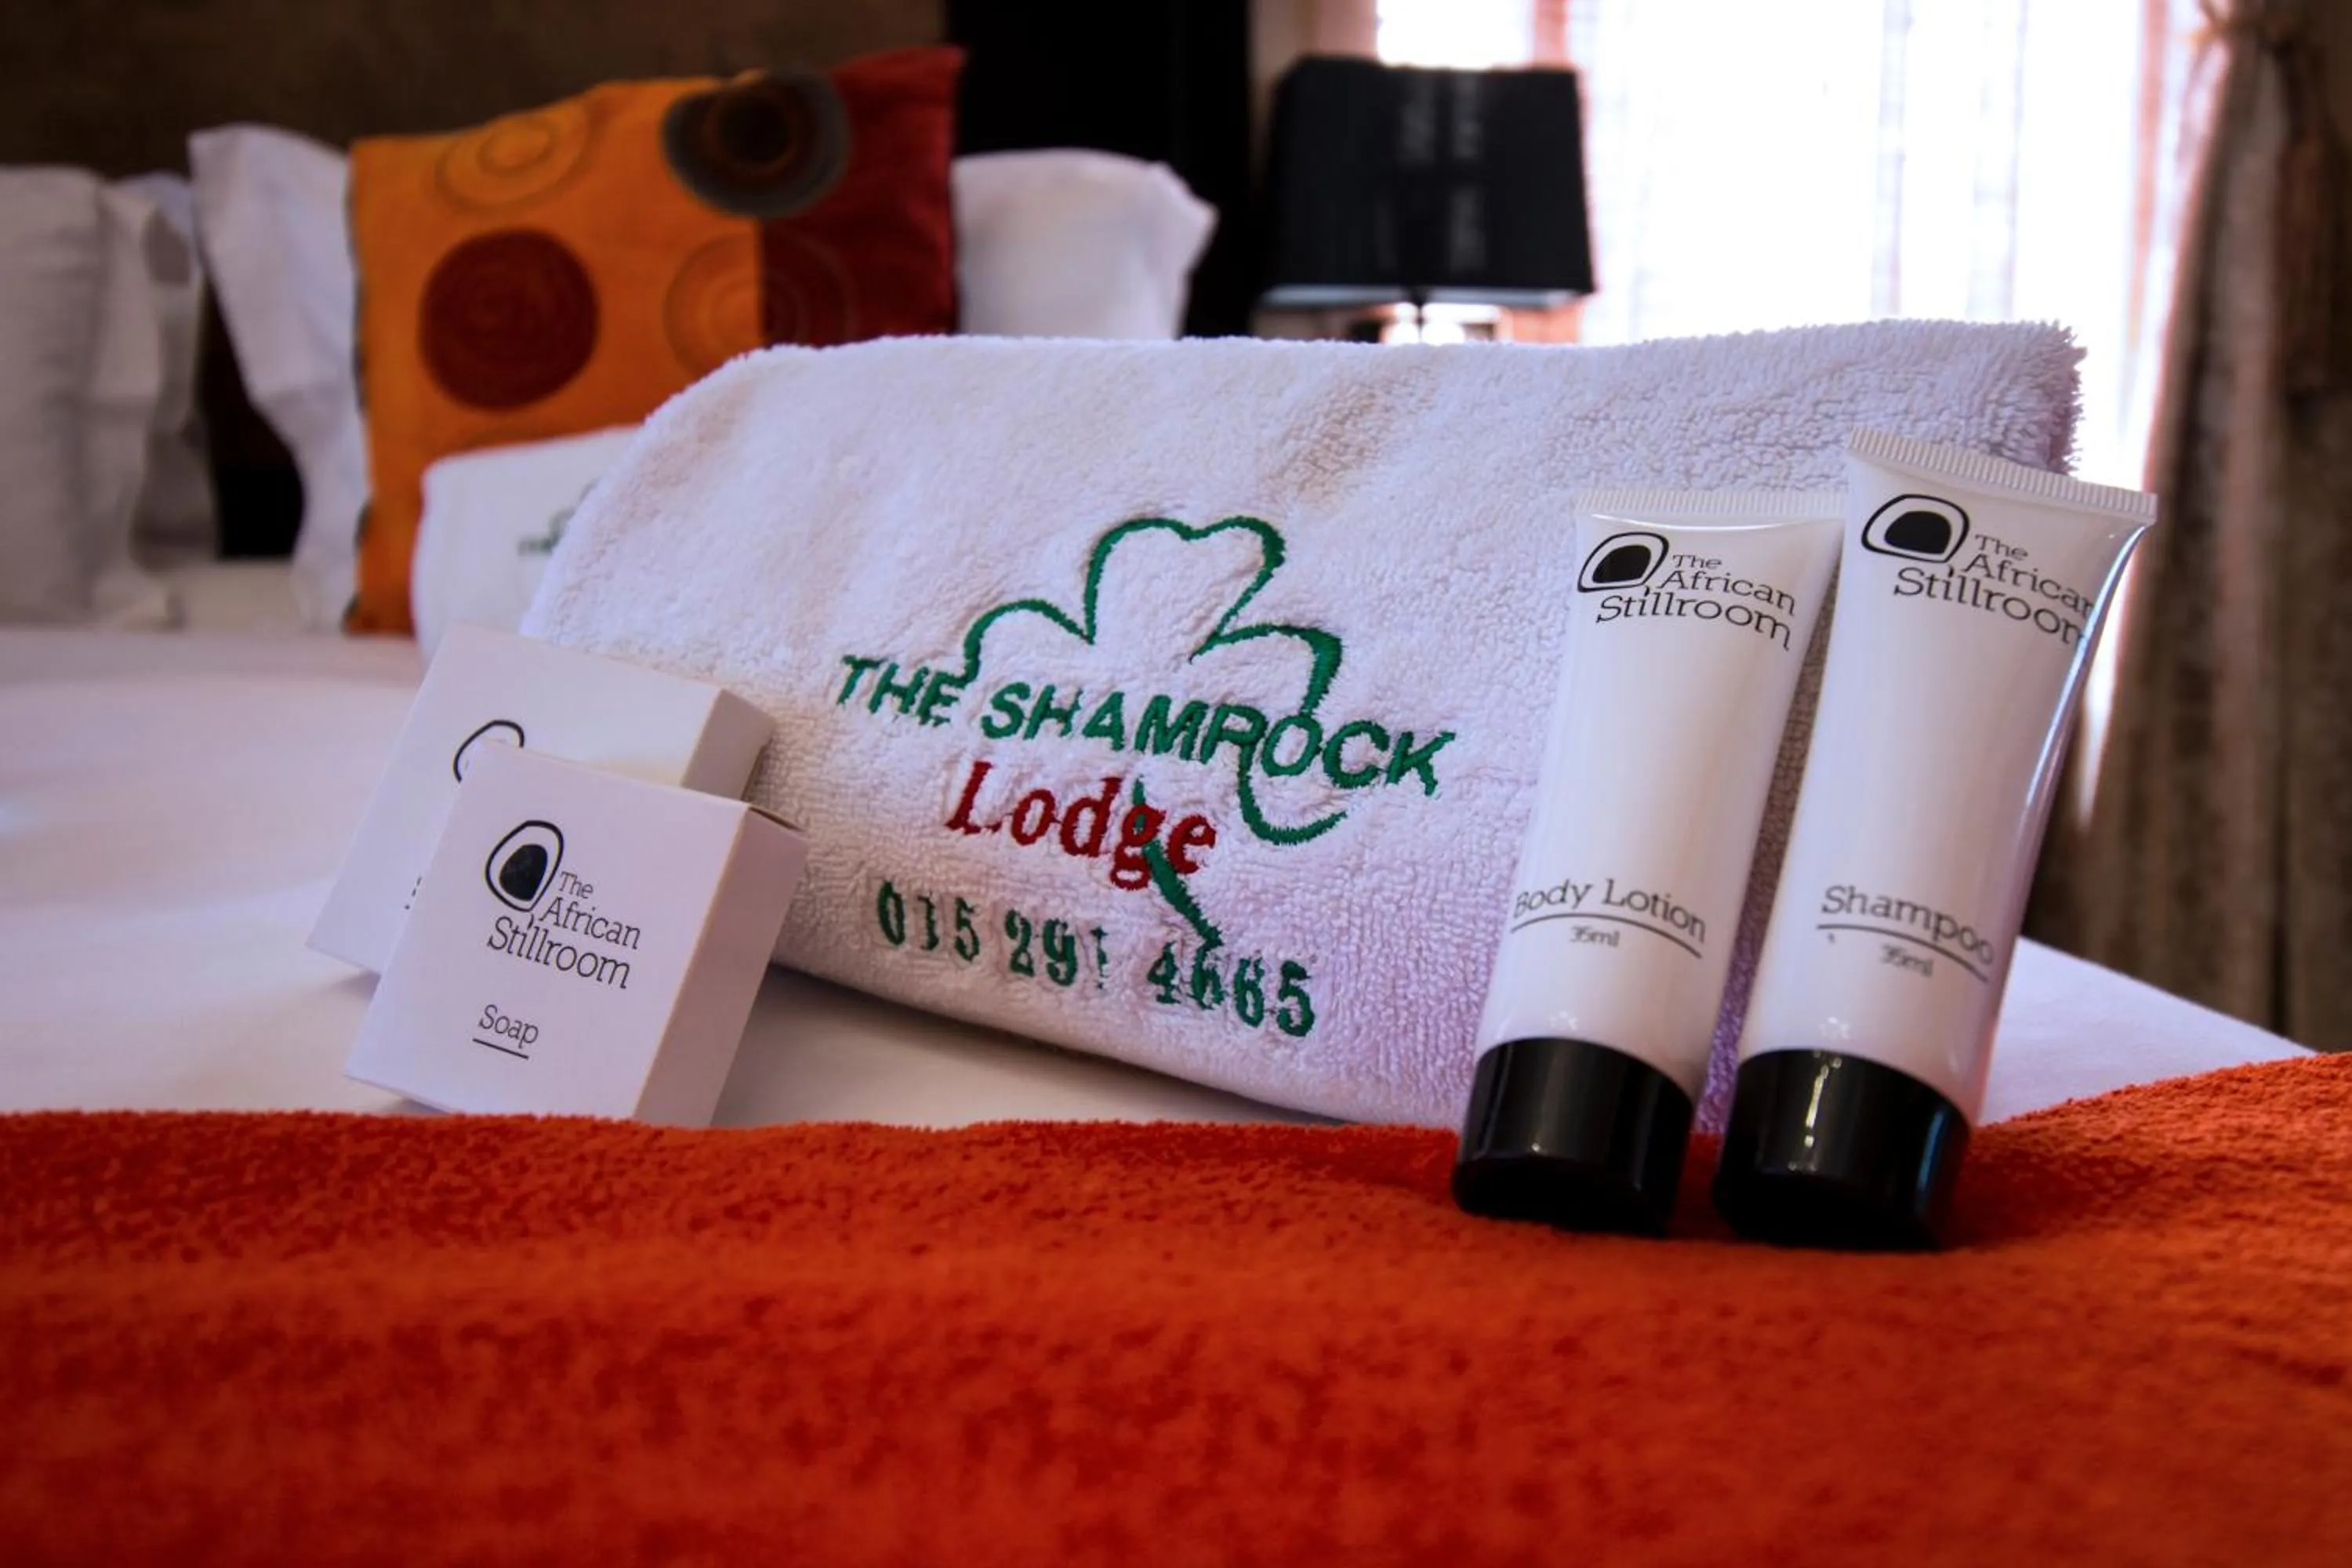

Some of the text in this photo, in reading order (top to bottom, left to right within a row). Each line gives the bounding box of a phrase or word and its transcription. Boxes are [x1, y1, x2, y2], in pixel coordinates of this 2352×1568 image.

[1671, 554, 1723, 570] The
[1973, 533, 2029, 561] The
[1596, 585, 1791, 651] Stillroom
[1655, 569, 1795, 616] African
[837, 655, 1456, 795] THE SHAMROCK
[946, 760, 1218, 890] Lodge
[559, 872, 594, 899] The
[1513, 878, 1707, 944] Body Lotion
[487, 914, 630, 989] Stillroom
[539, 897, 641, 949] African
[877, 880, 980, 962] 015
[1821, 884, 1994, 966] Shampoo
[479, 1005, 539, 1047] Soap
